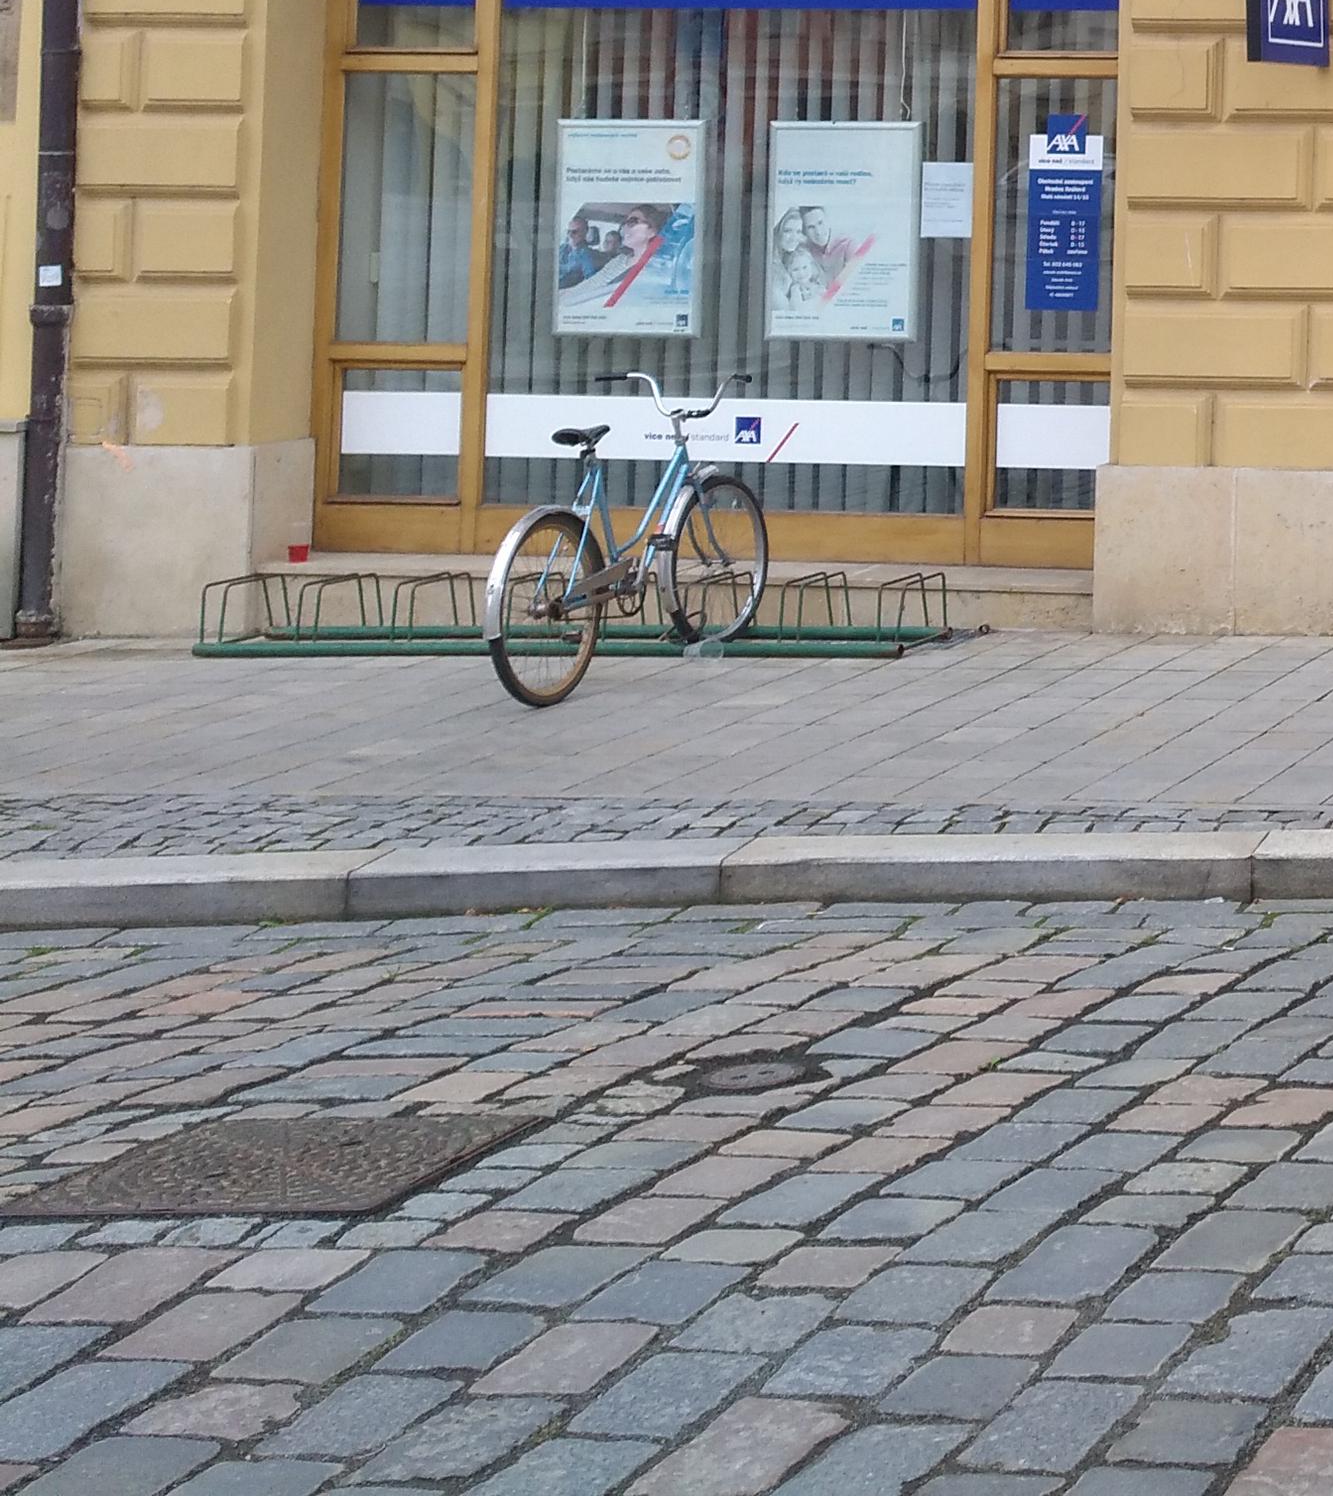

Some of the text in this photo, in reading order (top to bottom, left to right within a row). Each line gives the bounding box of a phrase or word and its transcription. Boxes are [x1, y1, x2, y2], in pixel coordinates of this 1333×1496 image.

[1047, 134, 1079, 152] AXA
[690, 432, 730, 442] standard
[735, 430, 757, 443] AXA
